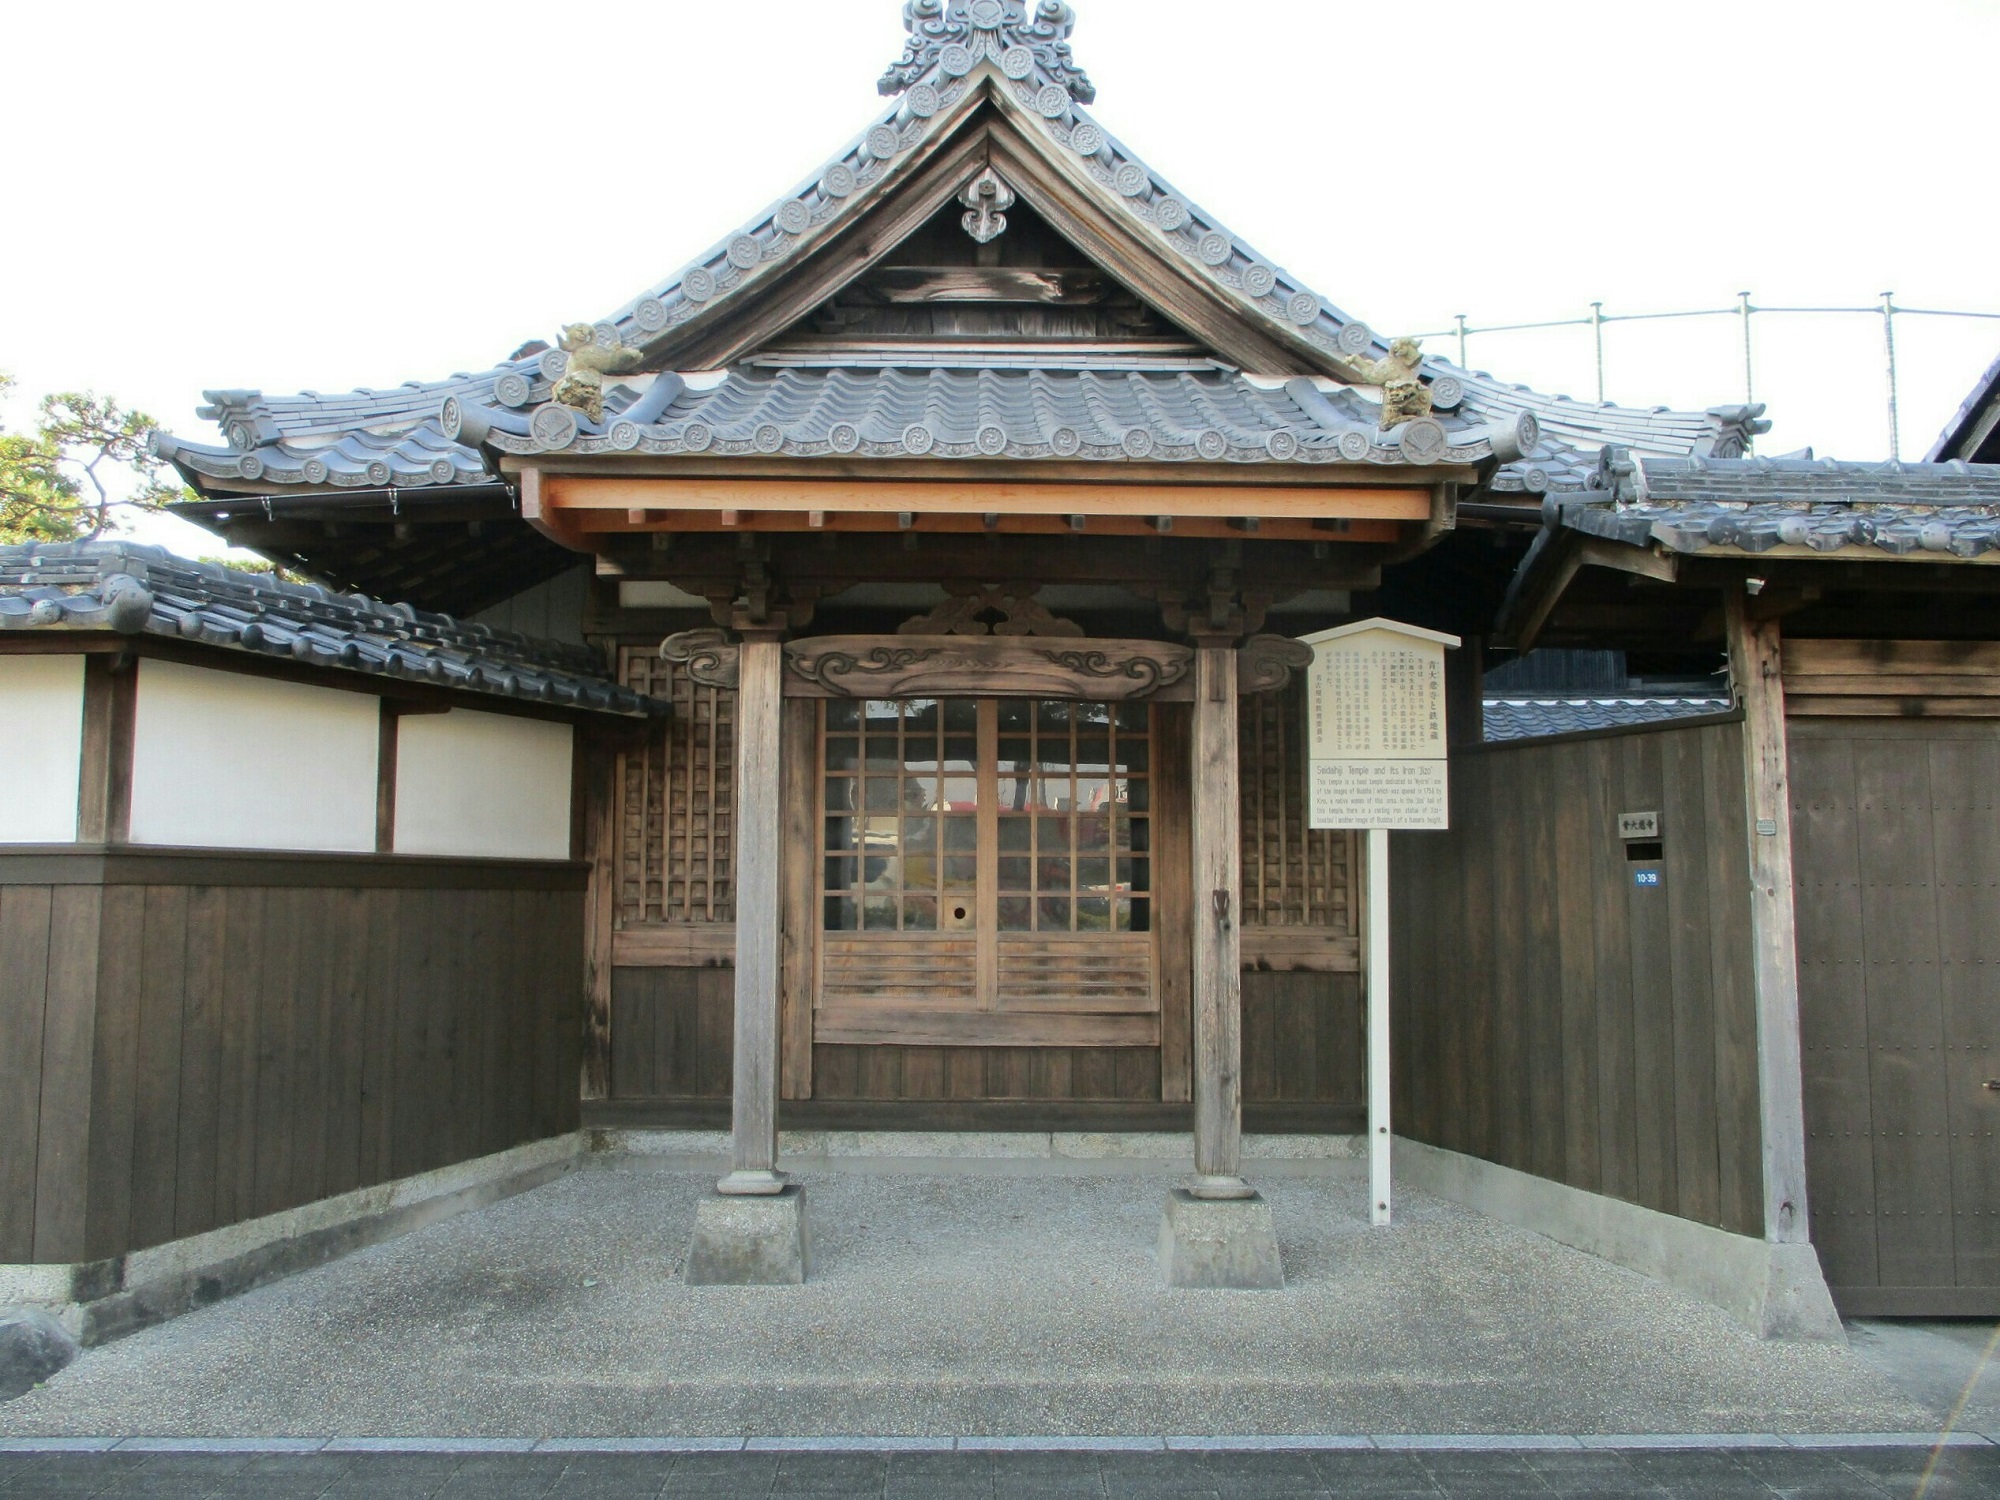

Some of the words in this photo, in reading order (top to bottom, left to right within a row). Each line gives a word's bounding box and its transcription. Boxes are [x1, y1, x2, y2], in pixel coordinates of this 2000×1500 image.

[1348, 765, 1369, 776] Temple
[1374, 765, 1385, 776] and
[1403, 765, 1415, 776] Iron
[1637, 873, 1657, 883] 10-39
